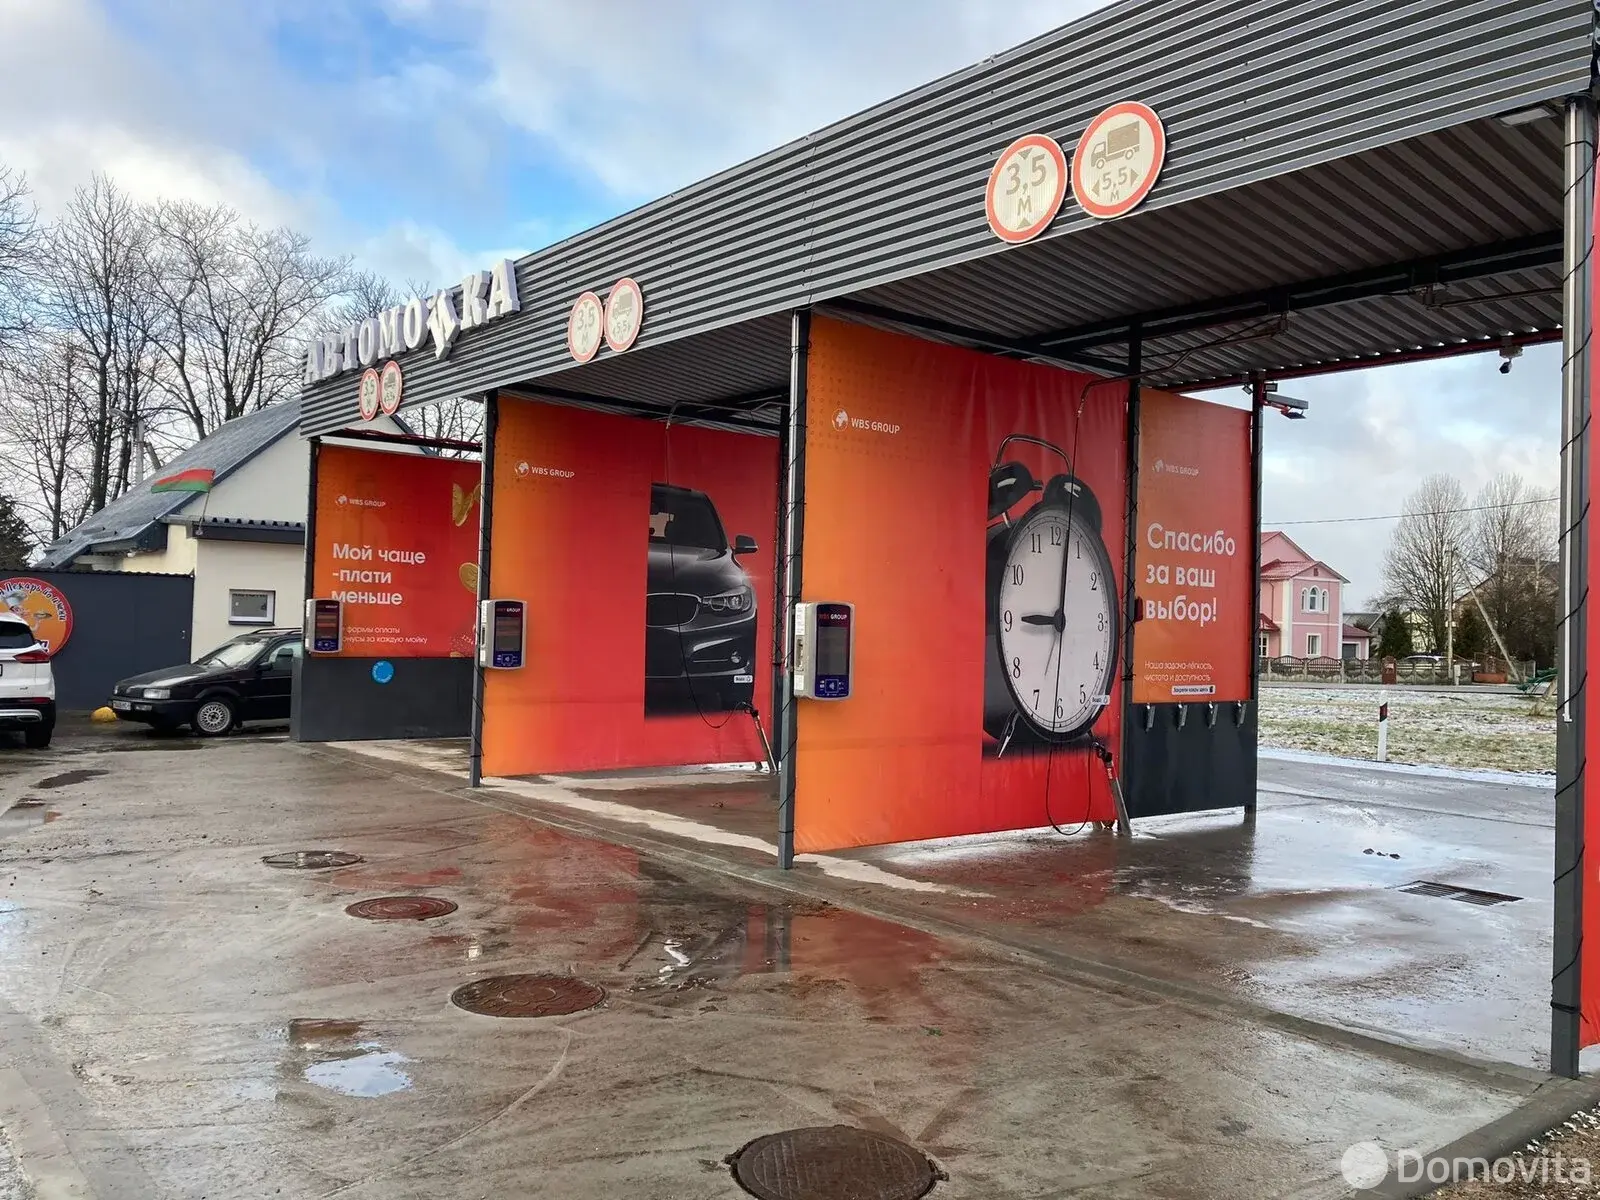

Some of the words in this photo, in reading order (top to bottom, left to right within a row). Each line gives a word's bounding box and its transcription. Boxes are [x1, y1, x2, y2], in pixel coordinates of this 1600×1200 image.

[1006, 154, 1046, 196] 3,5
[1102, 166, 1128, 191] 5,5
[851, 417, 869, 430] WBS
[872, 421, 901, 434] GROUP
[531, 465, 548, 475] WBS
[549, 468, 575, 478] GROUP
[1031, 533, 1042, 553] 11
[1050, 526, 1061, 546] 12
[1147, 522, 1236, 556] Спасибо
[332, 543, 373, 561] Мой
[378, 551, 426, 565] чаще
[1076, 541, 1081, 558] 1
[1012, 564, 1024, 586] 10
[1091, 572, 1098, 591] 2
[1146, 564, 1169, 585] за
[1175, 568, 1216, 587] ваш
[1004, 610, 1013, 632] 9
[1145, 595, 1217, 627] выбор!
[1097, 613, 1104, 631] 3
[1013, 657, 1021, 678] 8
[1093, 651, 1099, 670] 4
[1033, 689, 1040, 710] 7
[1079, 684, 1086, 704] 5
[1056, 698, 1063, 719] 6
